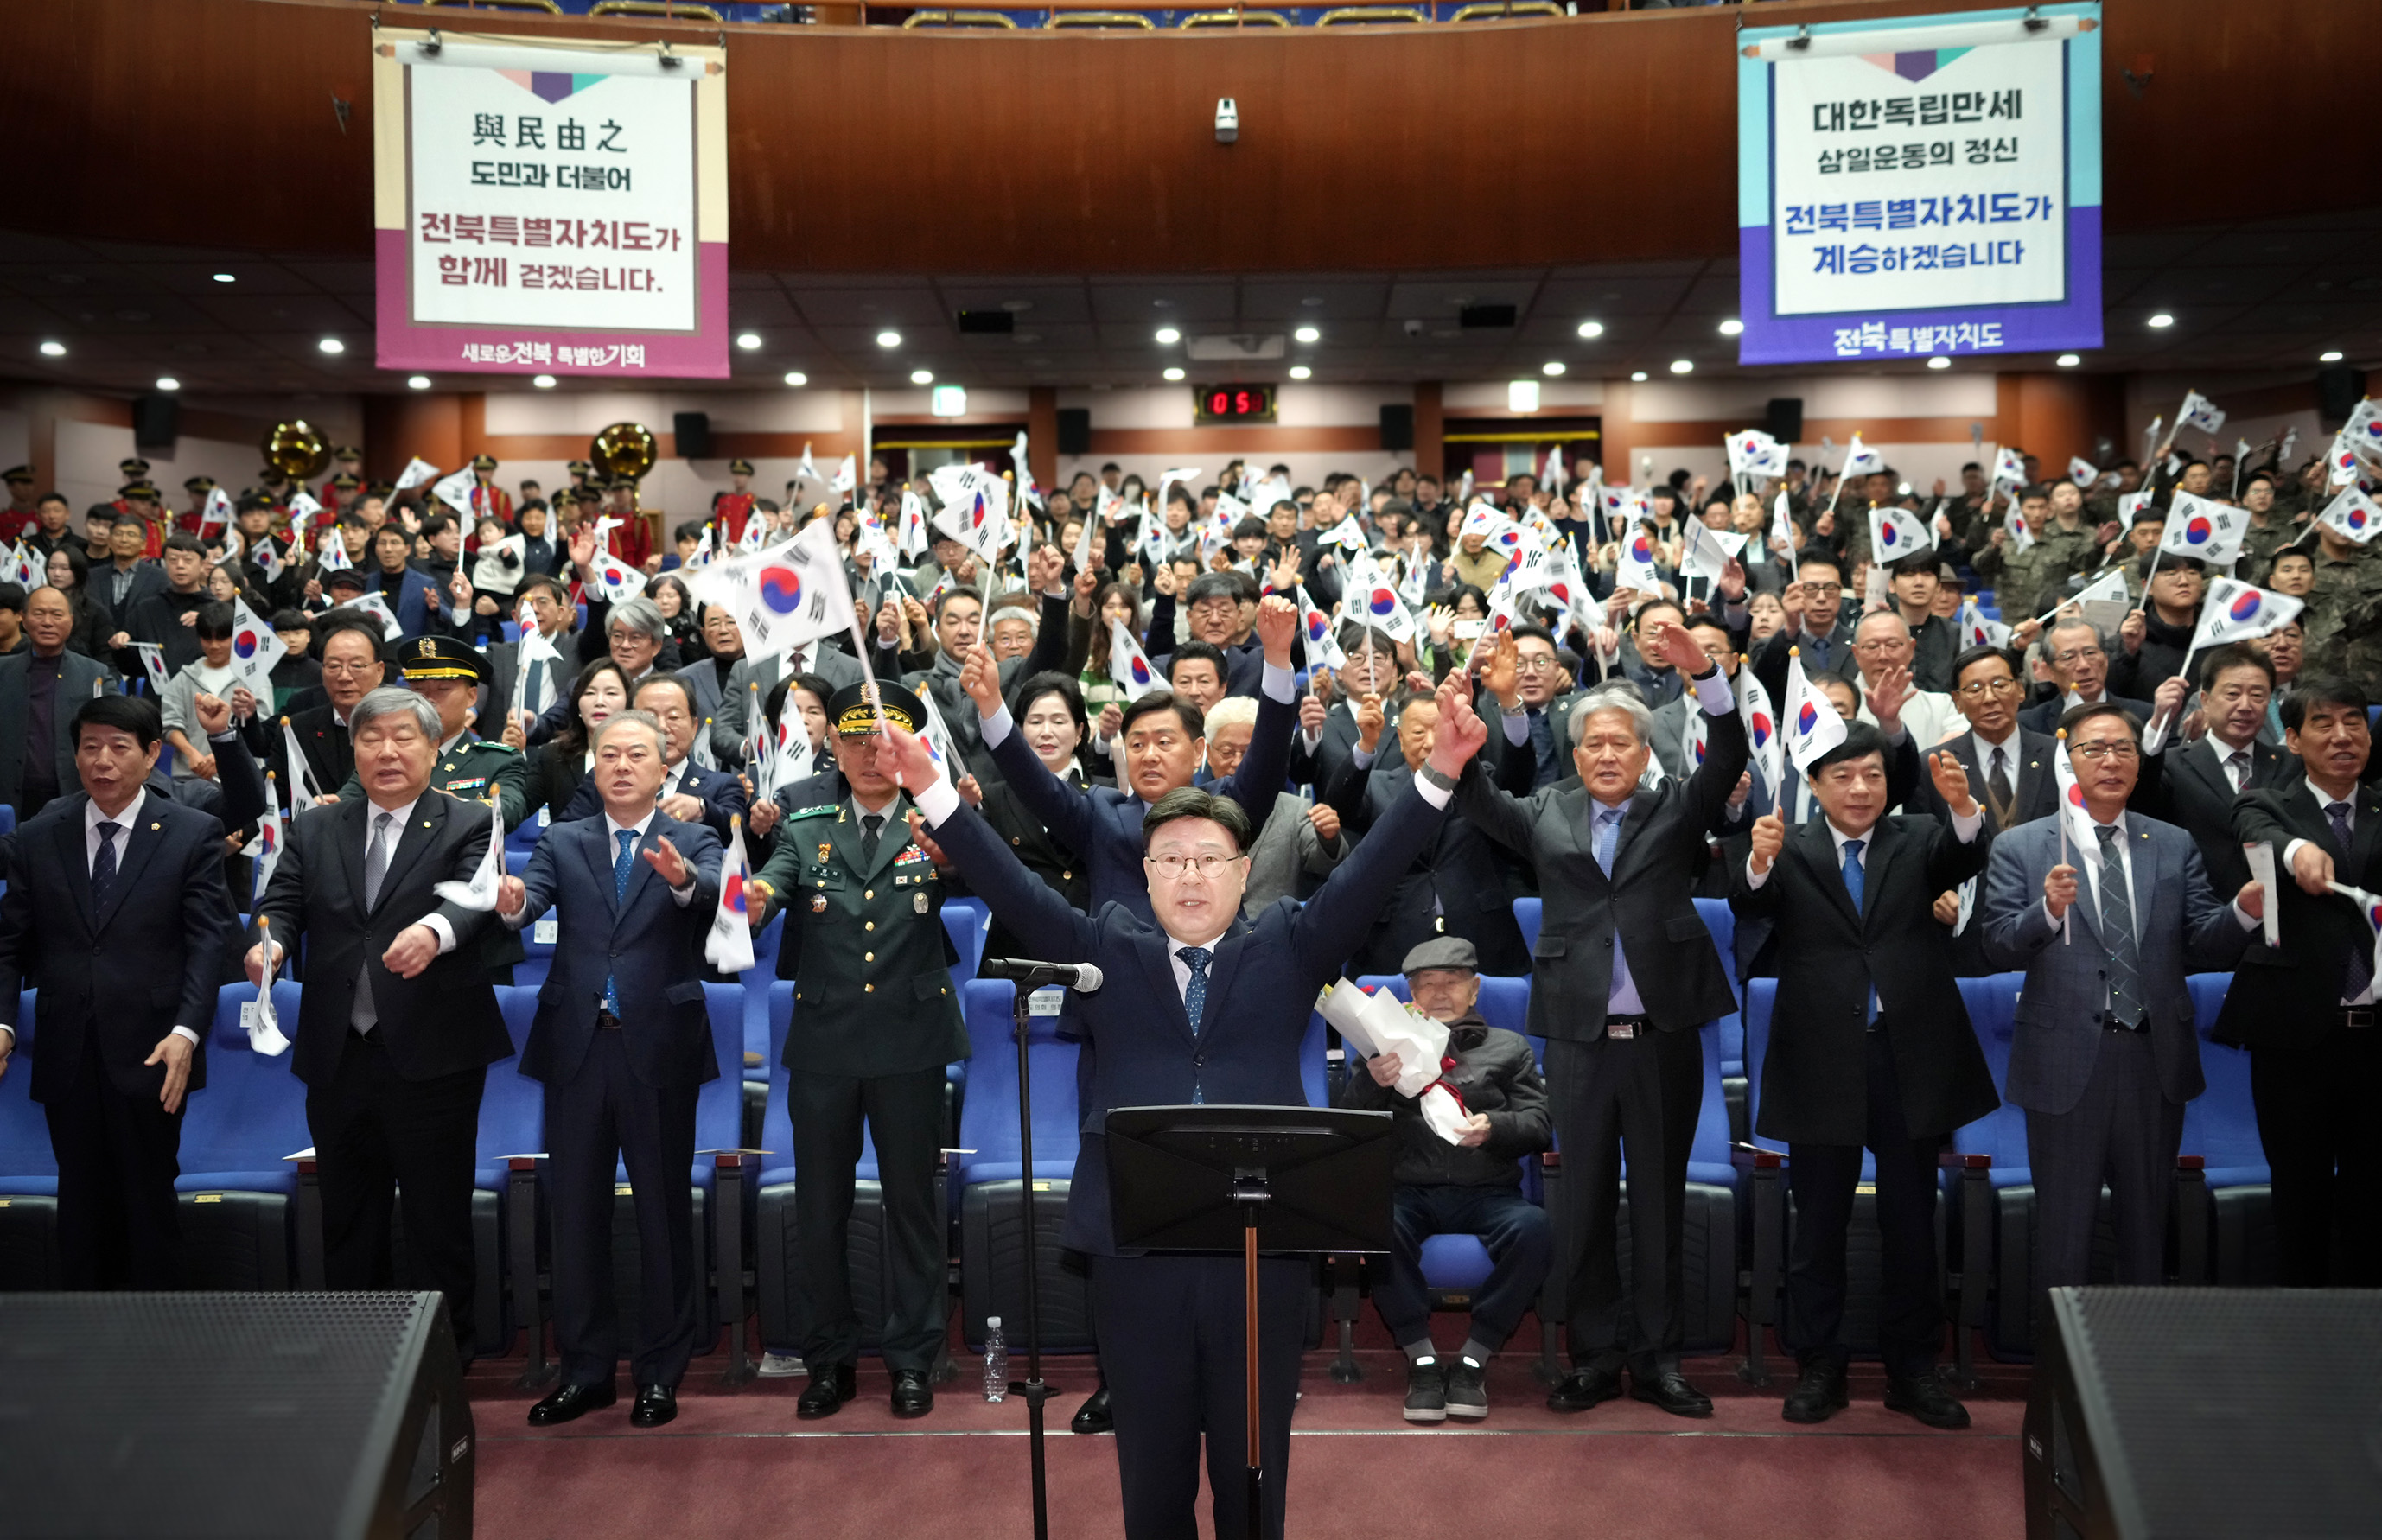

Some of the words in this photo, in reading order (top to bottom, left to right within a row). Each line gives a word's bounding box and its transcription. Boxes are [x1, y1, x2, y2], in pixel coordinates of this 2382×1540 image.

[1813, 89, 2022, 132] 대한독립만세
[472, 112, 628, 152] 與民由之
[1818, 141, 1953, 174] 삼일운동의
[1964, 137, 2019, 165] 정신
[470, 161, 550, 188] 도민과
[556, 165, 632, 191] 더불어
[420, 213, 681, 251] 전북특별자치도가
[1786, 192, 2053, 236] 전북특별자치도가
[438, 254, 508, 287] 함께
[519, 264, 663, 293] 걷겠습니다.
[1813, 240, 2025, 276] 계승하겠습니다
[1833, 321, 2004, 356] 전북특별자치도
